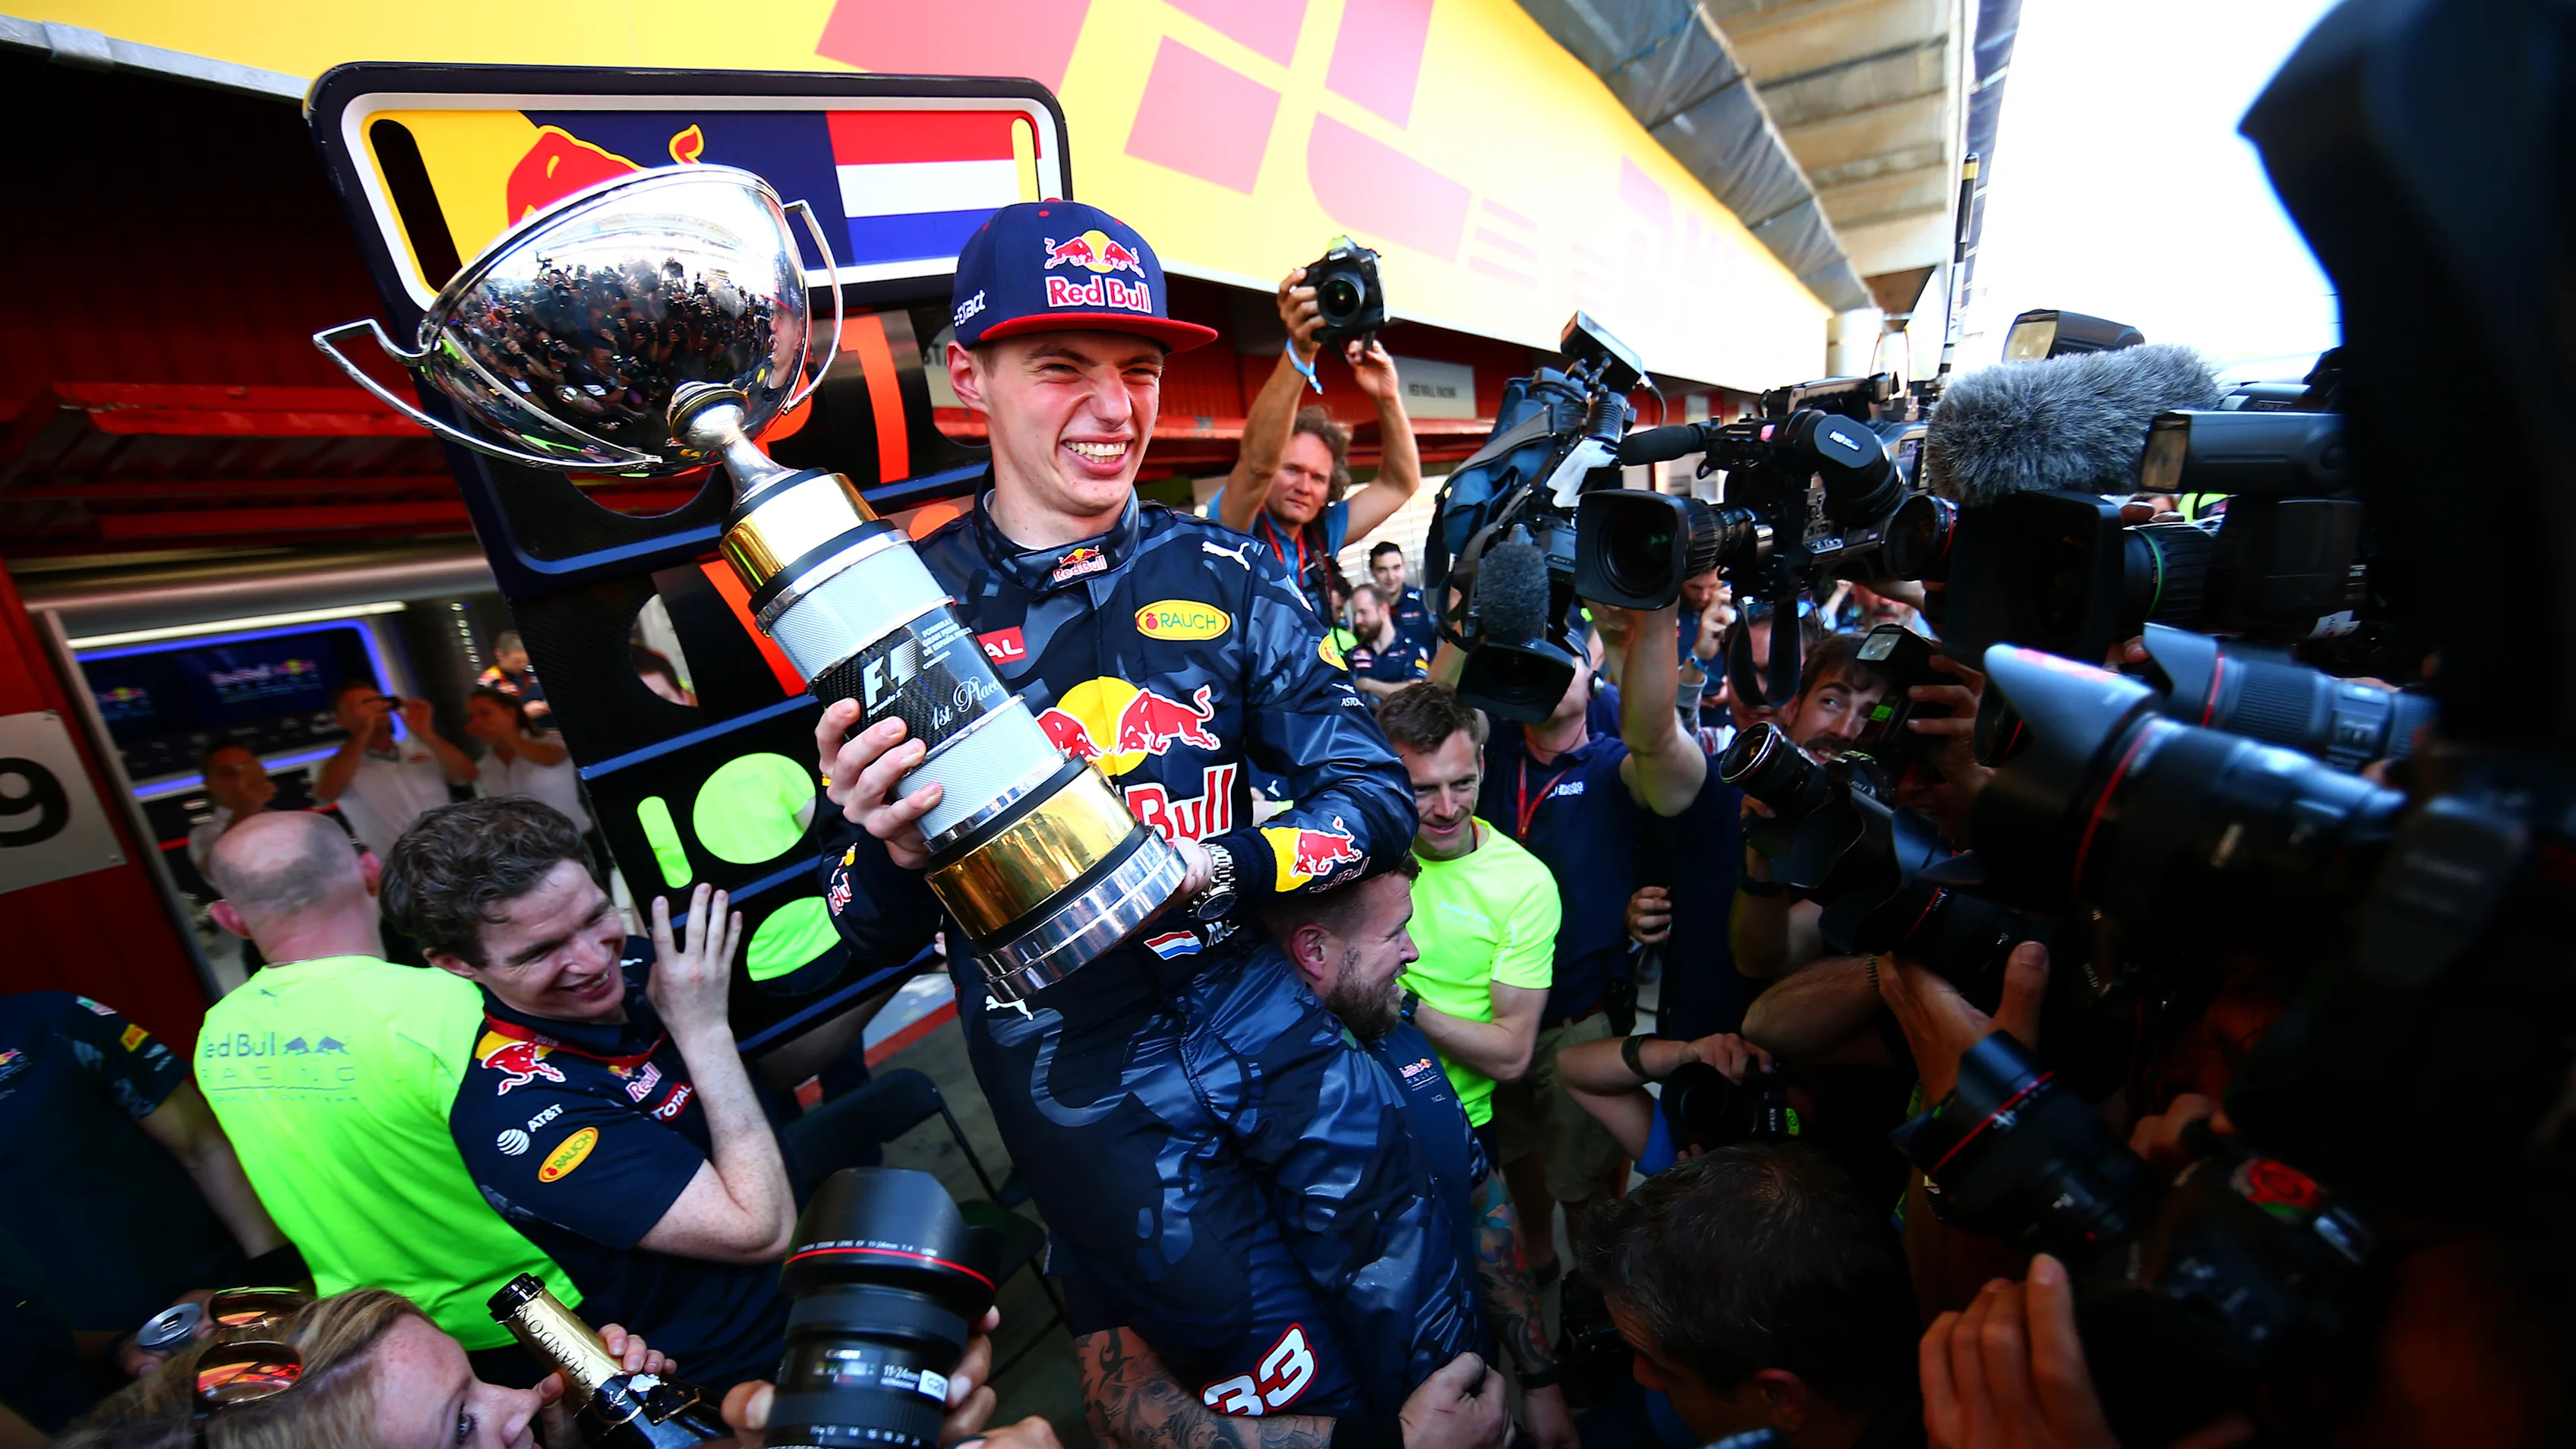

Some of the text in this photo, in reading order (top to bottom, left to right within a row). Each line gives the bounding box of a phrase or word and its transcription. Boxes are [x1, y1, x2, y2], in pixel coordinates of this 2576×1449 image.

[1046, 275, 1152, 314] Red Bull
[1053, 555, 1108, 582] Red Bull
[1160, 612, 1217, 630] RAUCH
[930, 706, 954, 731] 1st
[0, 757, 70, 848] 9
[1125, 762, 1238, 842] Bull
[204, 1032, 231, 1058] ed
[200, 1065, 355, 1083] ACG
[527, 1103, 564, 1132] AT&T
[650, 1084, 693, 1121] TOTAL
[1768, 1107, 1777, 1132] Nikon
[553, 1132, 592, 1170] RAUCH
[515, 1305, 593, 1387] CHANDON
[1200, 1323, 1318, 1417] 33
